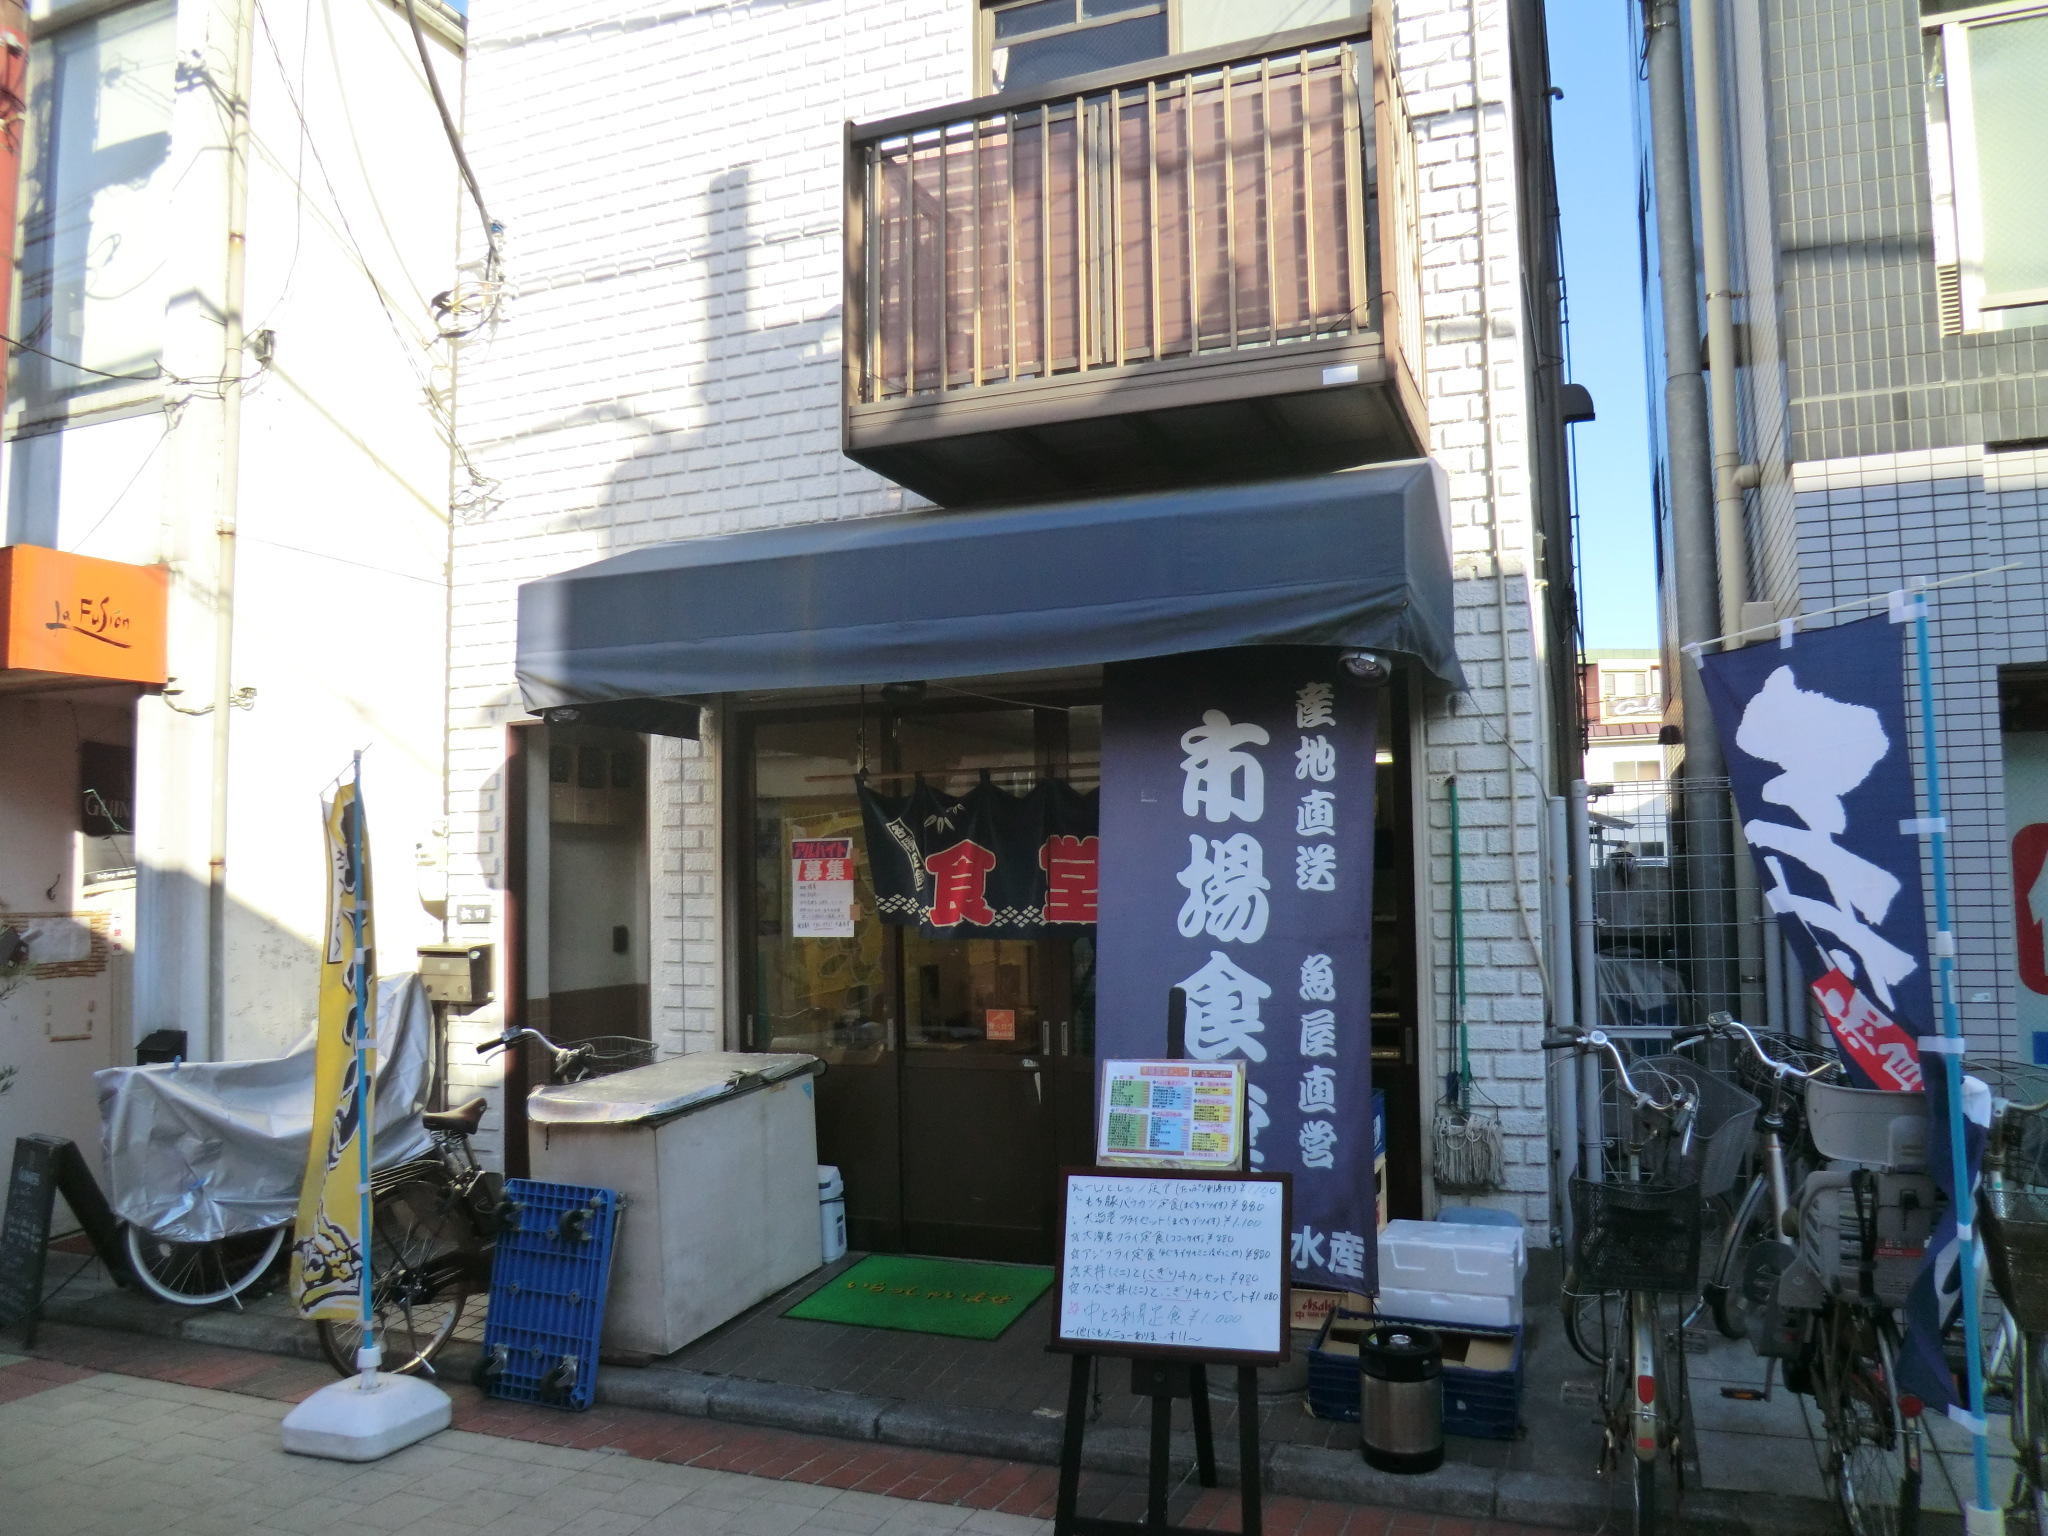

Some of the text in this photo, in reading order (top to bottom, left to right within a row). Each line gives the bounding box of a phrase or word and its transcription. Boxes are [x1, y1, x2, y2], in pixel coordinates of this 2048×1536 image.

[804, 860, 844, 880] 募集
[924, 838, 1099, 927] 食堂
[1295, 681, 1336, 892] 産地直送
[1177, 708, 1270, 1172] 市場食
[1298, 953, 1336, 1169] 魚屋直営
